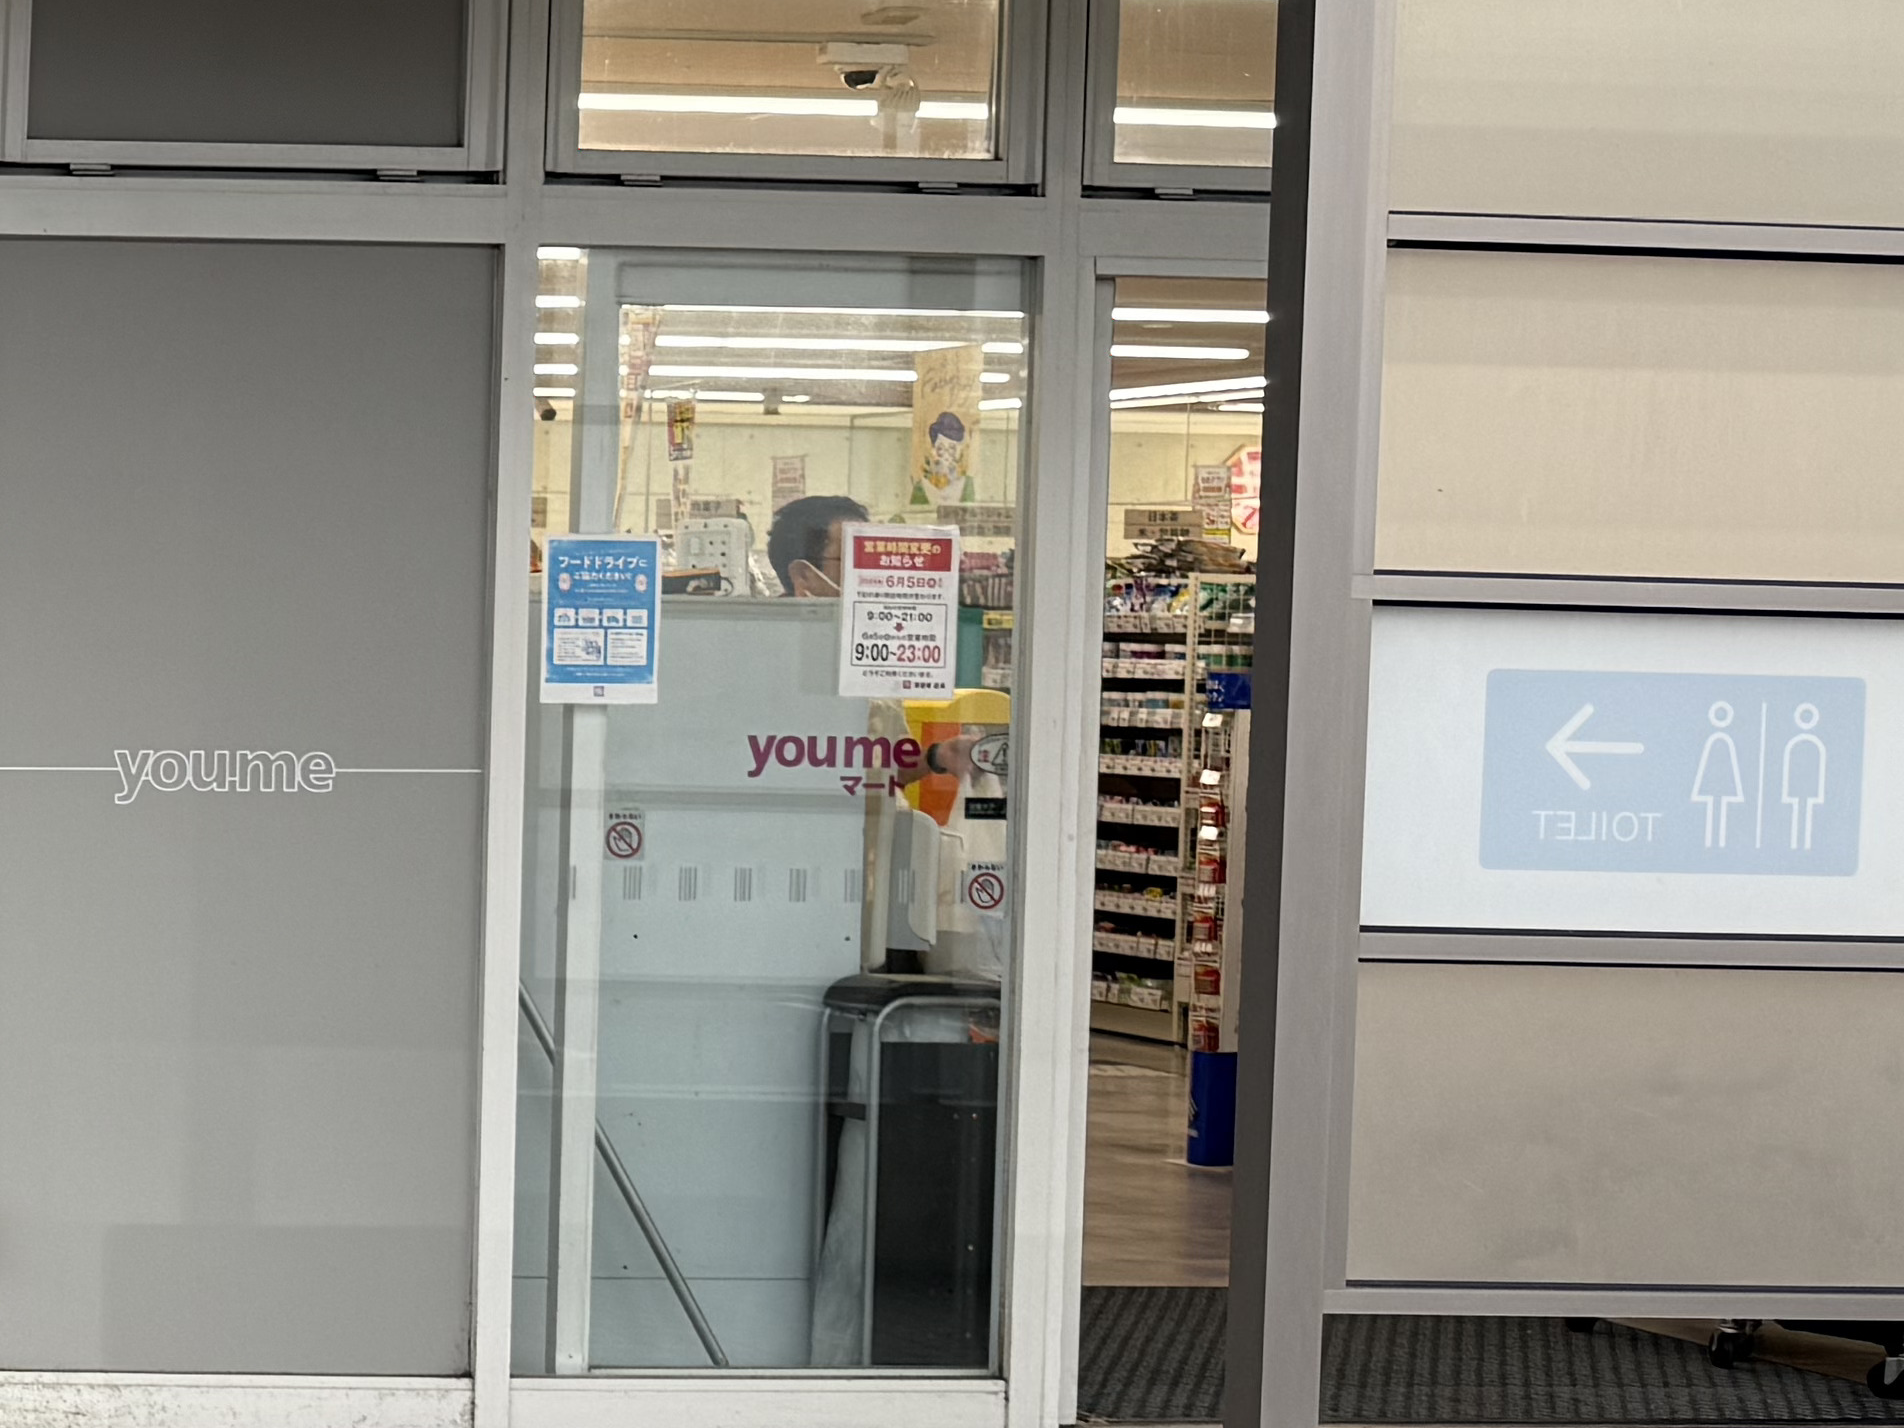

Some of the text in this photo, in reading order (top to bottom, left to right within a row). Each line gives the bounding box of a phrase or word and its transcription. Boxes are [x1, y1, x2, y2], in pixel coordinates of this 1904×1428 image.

[114, 749, 336, 804] youme
[747, 734, 922, 777] youme
[839, 775, 906, 797] マート
